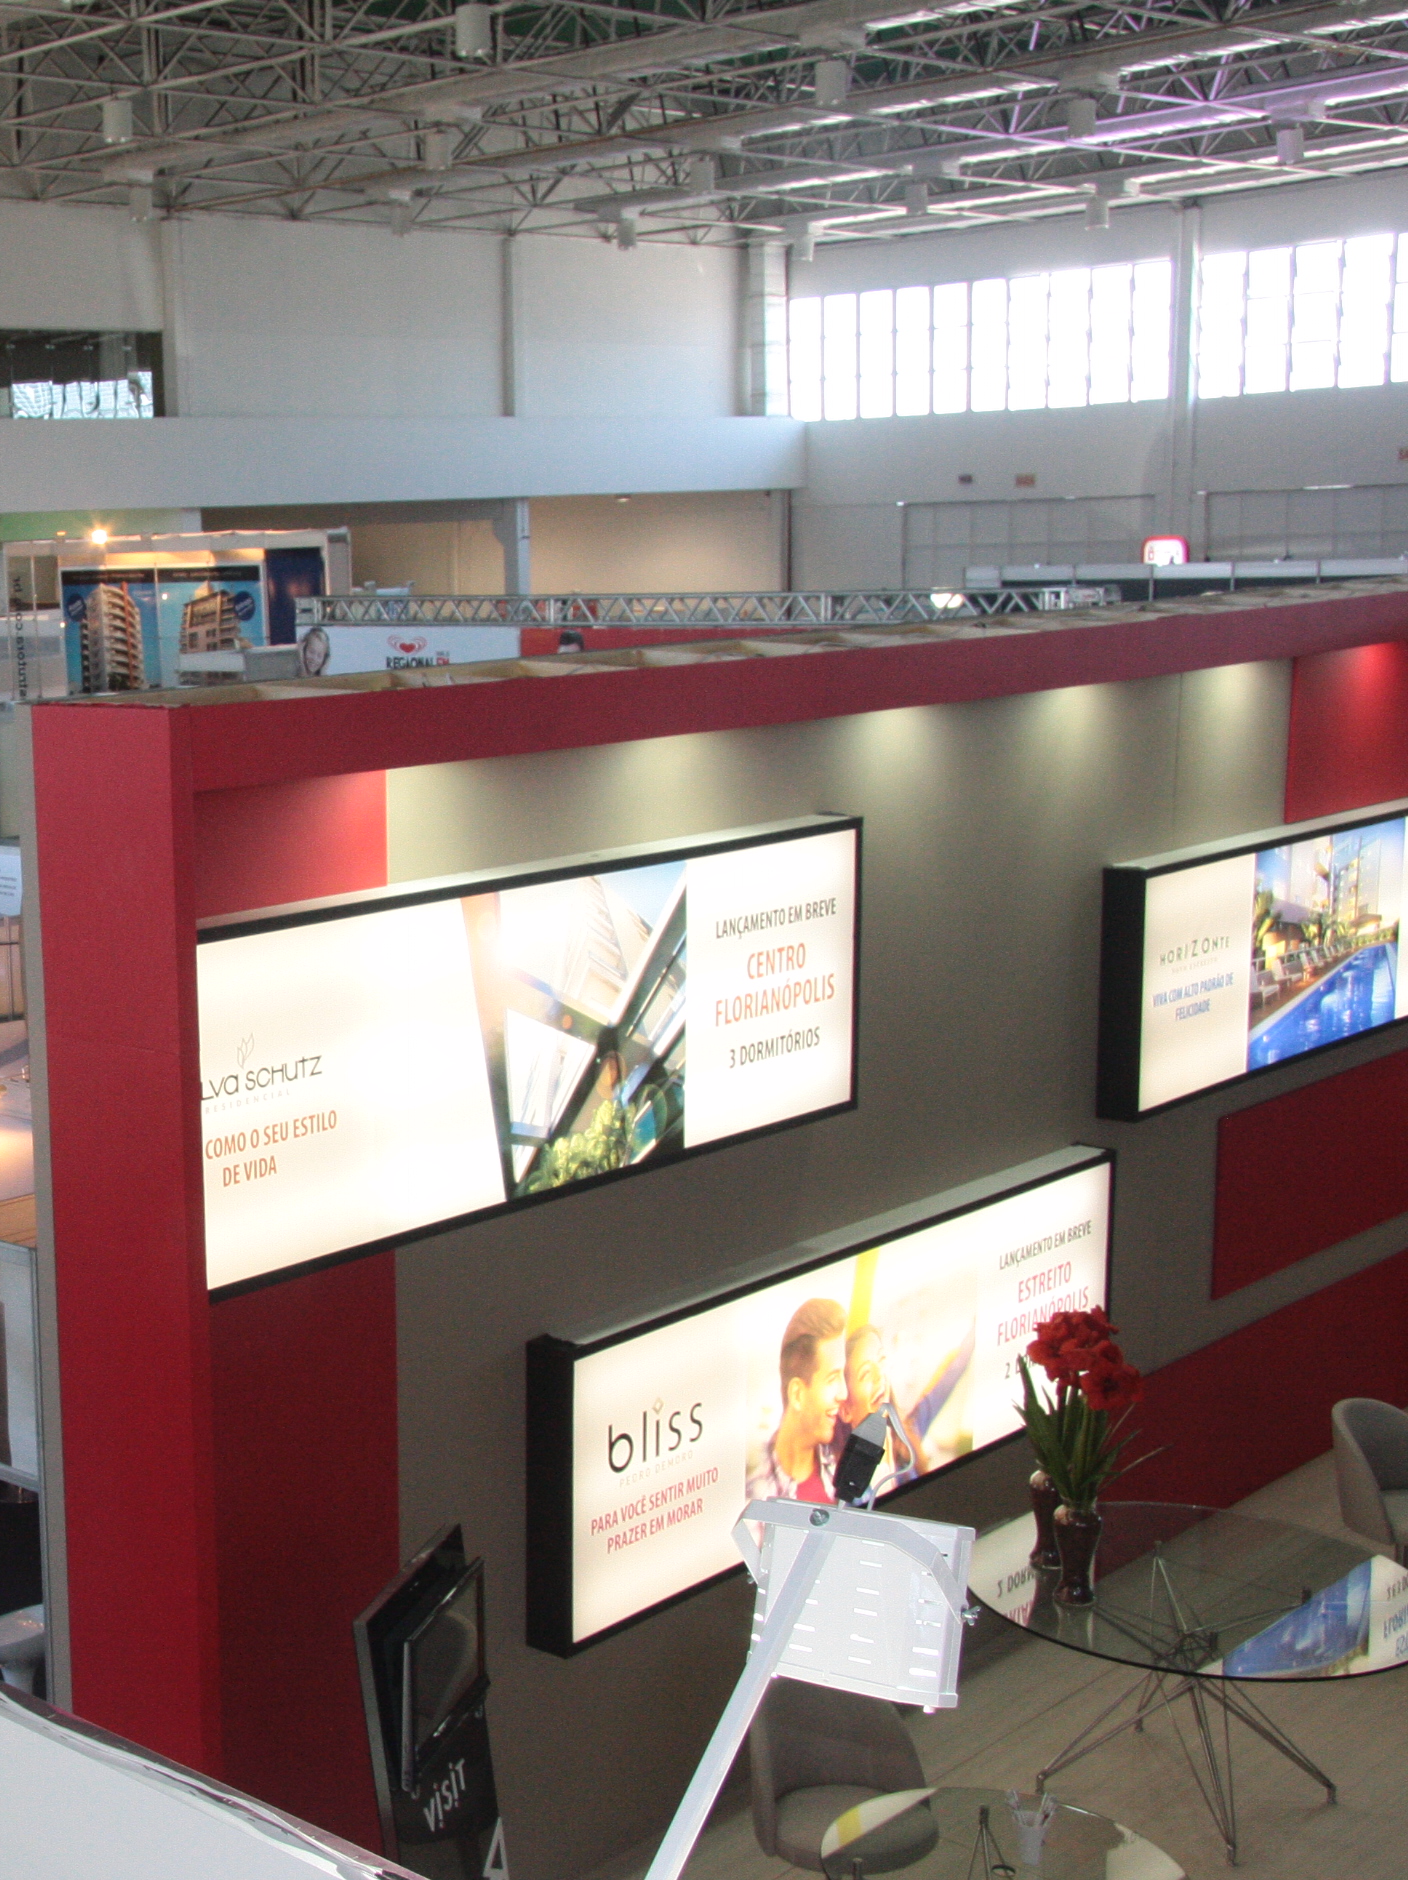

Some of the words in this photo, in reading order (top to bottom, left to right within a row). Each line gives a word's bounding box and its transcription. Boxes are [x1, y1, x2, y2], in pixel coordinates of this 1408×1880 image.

[715, 907, 786, 940] LANÇAMENTO
[788, 904, 803, 924] EM
[805, 897, 836, 921] BREVE
[747, 942, 806, 980] CENTRO
[1159, 936, 1230, 966] HORIZONTE
[715, 973, 835, 1027] FLORIANÓPOLIS
[729, 1049, 736, 1069] 3
[740, 1026, 820, 1066] DORMITÓRIOS
[205, 1088, 291, 1115] RESIDENCIAL
[205, 1132, 247, 1160] COMO
[250, 1128, 260, 1149] O
[263, 1121, 289, 1146] SEU
[293, 1109, 338, 1139] ESTILO
[222, 1164, 241, 1188] DE
[244, 1155, 278, 1181] VIDA
[998, 1235, 1053, 1271] LANÇAMENTO
[1054, 1229, 1066, 1249] EM
[1067, 1219, 1092, 1244] BREVE
[1018, 1261, 1072, 1304] ESTREITO
[608, 1398, 703, 1474] bliss
[591, 1510, 619, 1537] PARA
[620, 1494, 647, 1523] VOCÊ
[648, 1482, 685, 1512] SENTIR
[686, 1467, 719, 1495] MUITO
[607, 1522, 647, 1555] PRAZER
[650, 1514, 665, 1535] EM
[666, 1498, 704, 1528] MORAR
